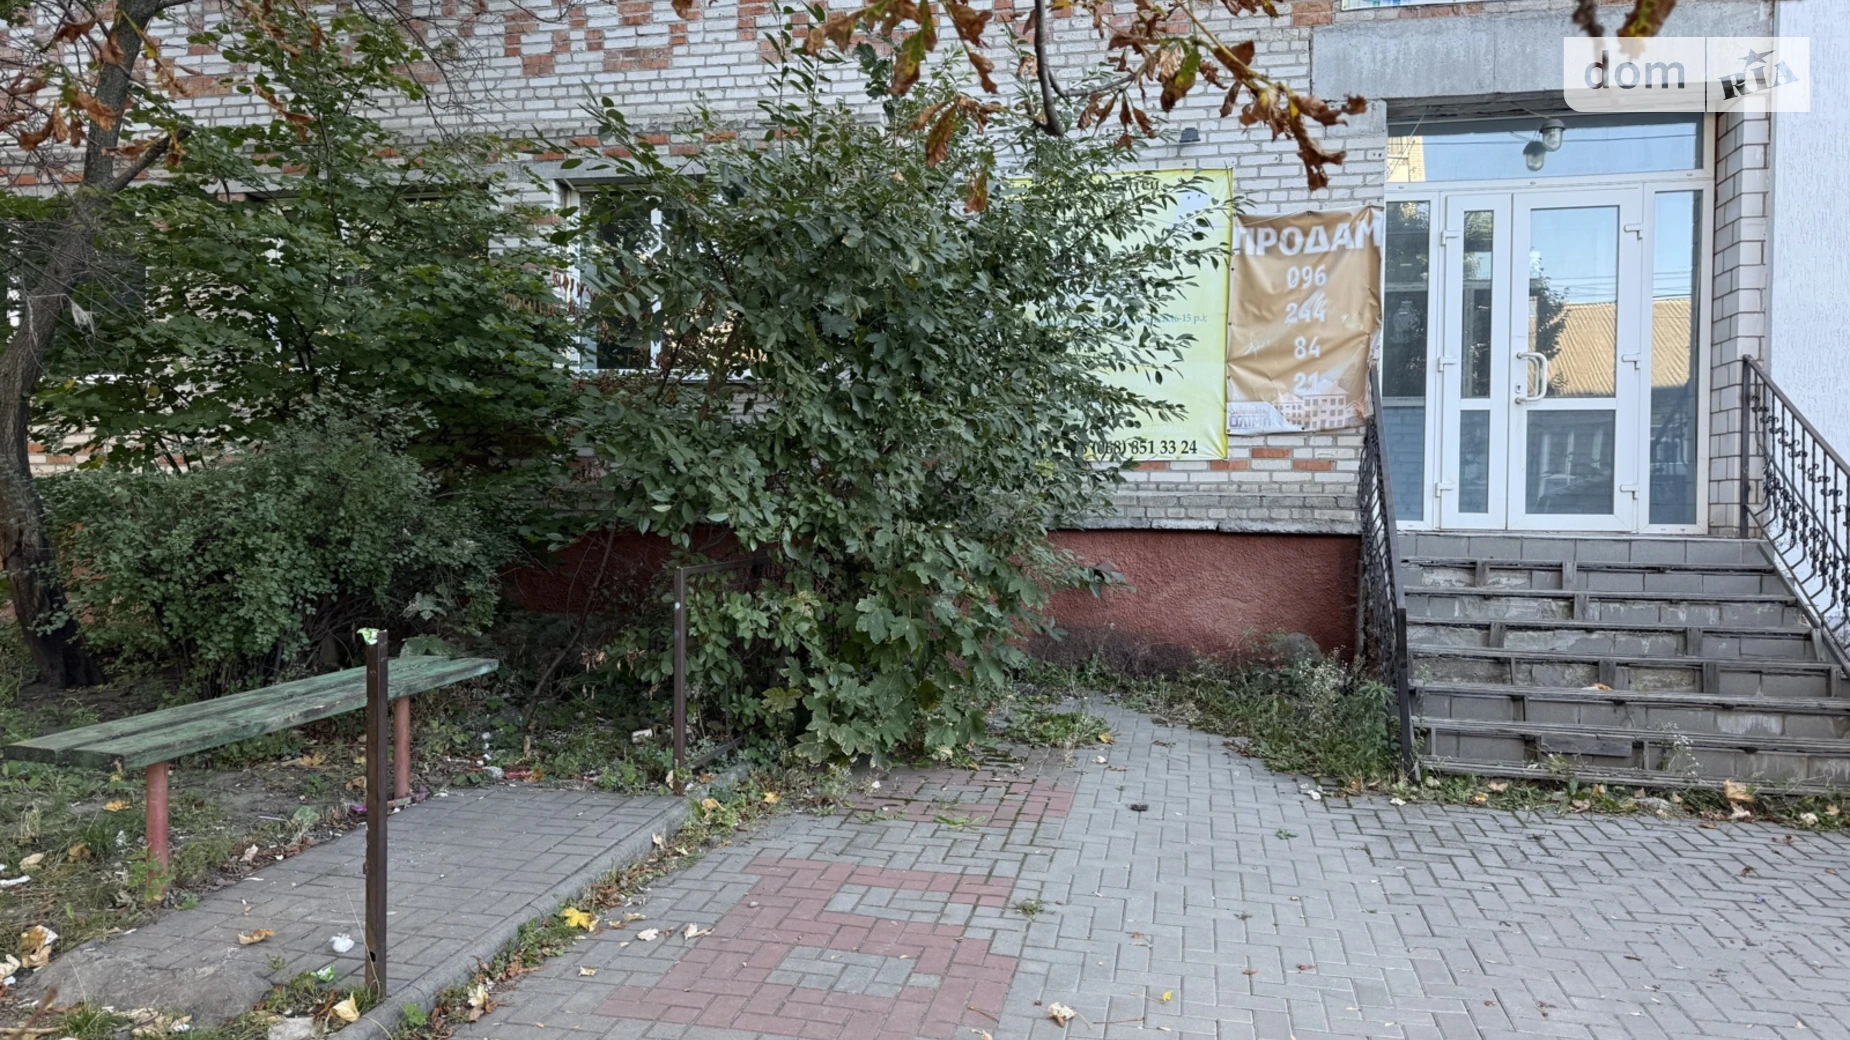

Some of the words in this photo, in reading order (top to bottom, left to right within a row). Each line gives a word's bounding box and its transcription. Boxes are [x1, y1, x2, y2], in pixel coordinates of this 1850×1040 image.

[1232, 216, 1382, 257] ПРОДАМ
[1286, 264, 1328, 289] 096
[1293, 336, 1321, 360] 84
[1131, 440, 1155, 454] 851
[1160, 440, 1176, 454] 33
[1181, 440, 1198, 454] 24
